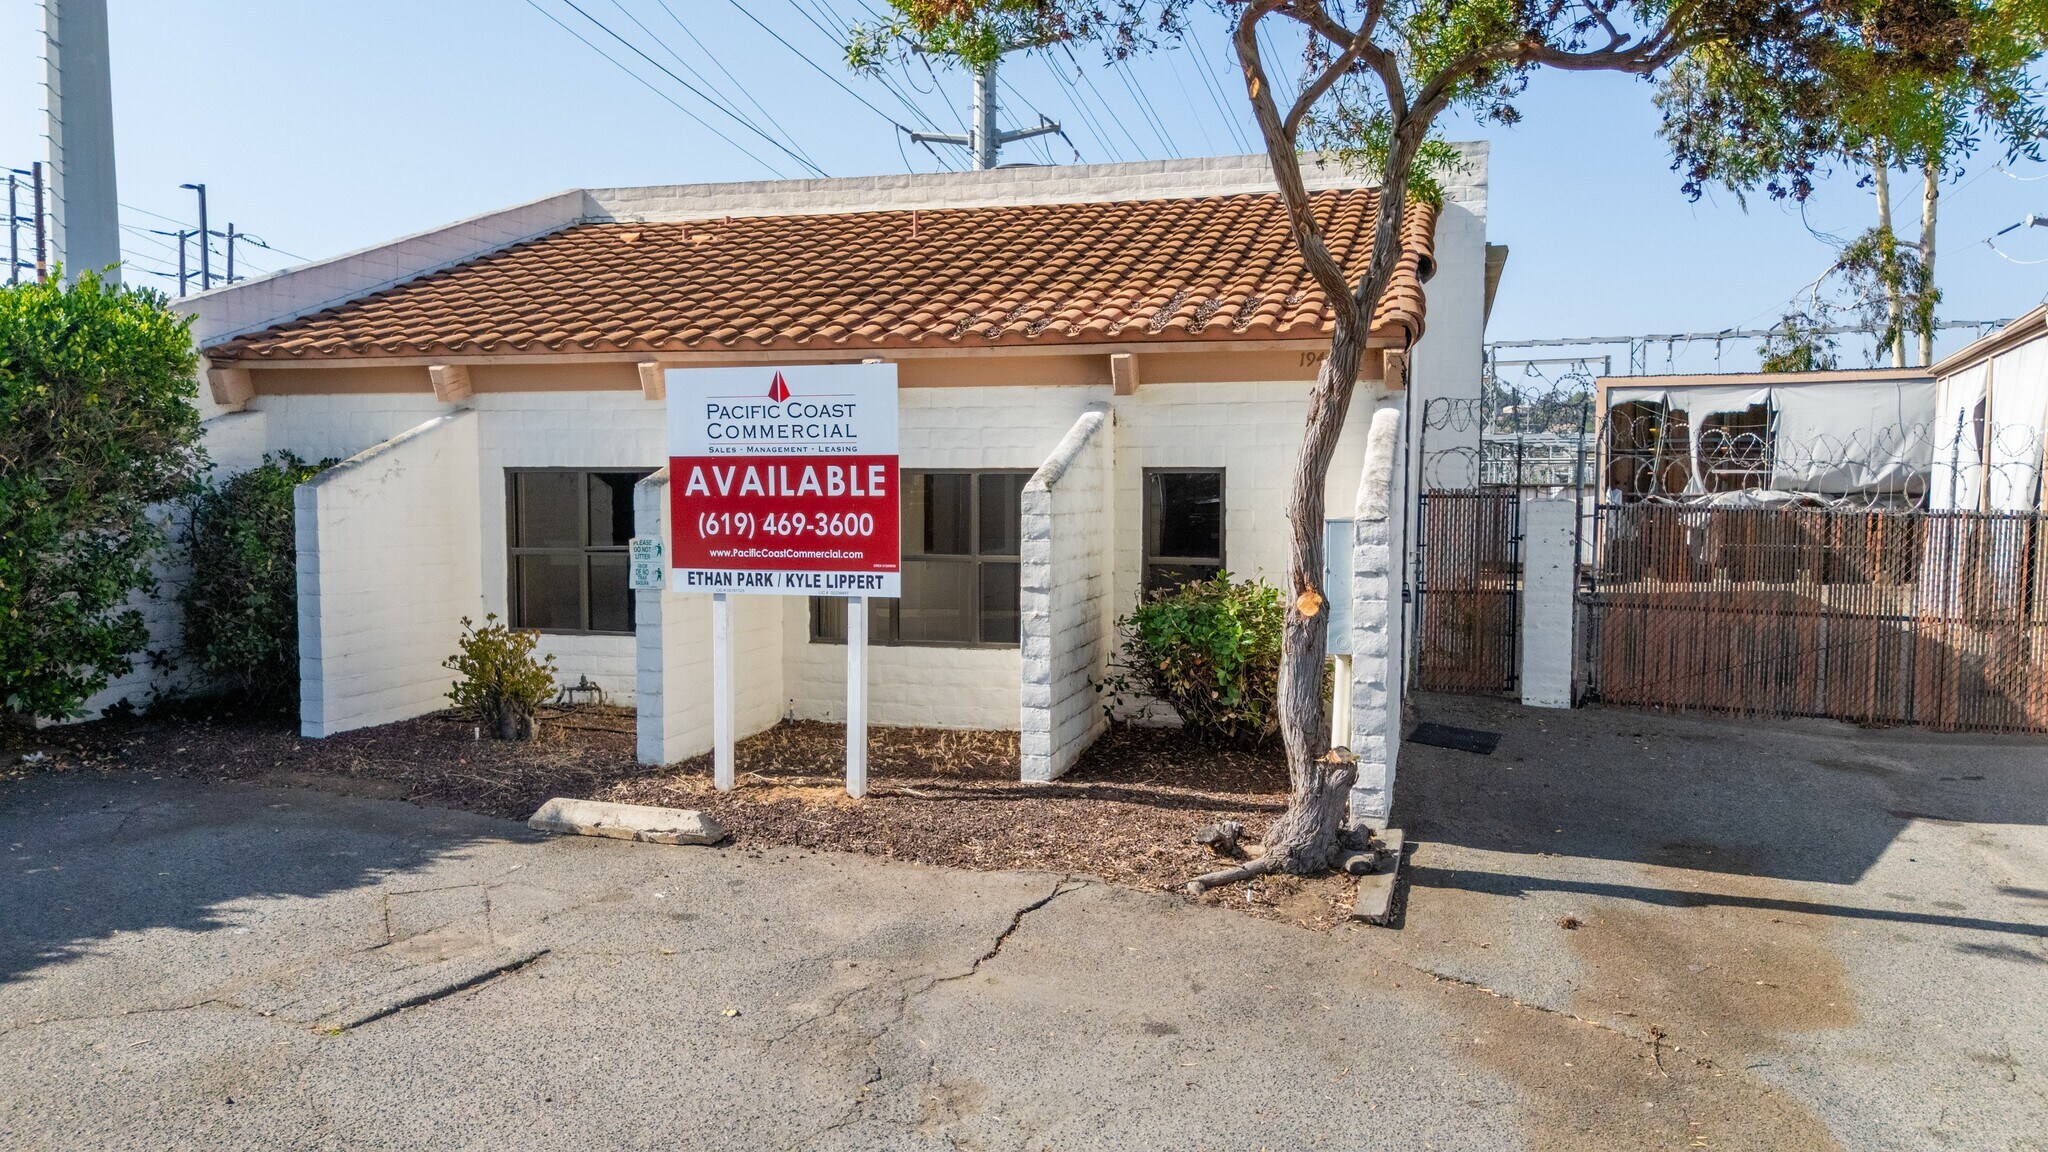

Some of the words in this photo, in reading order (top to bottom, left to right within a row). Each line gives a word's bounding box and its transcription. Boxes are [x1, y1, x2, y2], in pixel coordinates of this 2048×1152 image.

[706, 403, 781, 420] PACIFIC
[787, 402, 857, 418] COAST
[707, 423, 858, 440] COMMERCIAL
[708, 446, 738, 454] SALES
[818, 445, 858, 453] LEASING
[684, 465, 886, 497] AVAILABLE
[698, 512, 756, 540] (619)
[762, 512, 874, 537] 469-3600
[709, 548, 864, 560] www.PacificCoastCommercial.com
[687, 571, 733, 587] ETHAN
[737, 572, 774, 588] PARK
[785, 573, 822, 589] KYLE
[825, 574, 884, 590] LIPPERT
